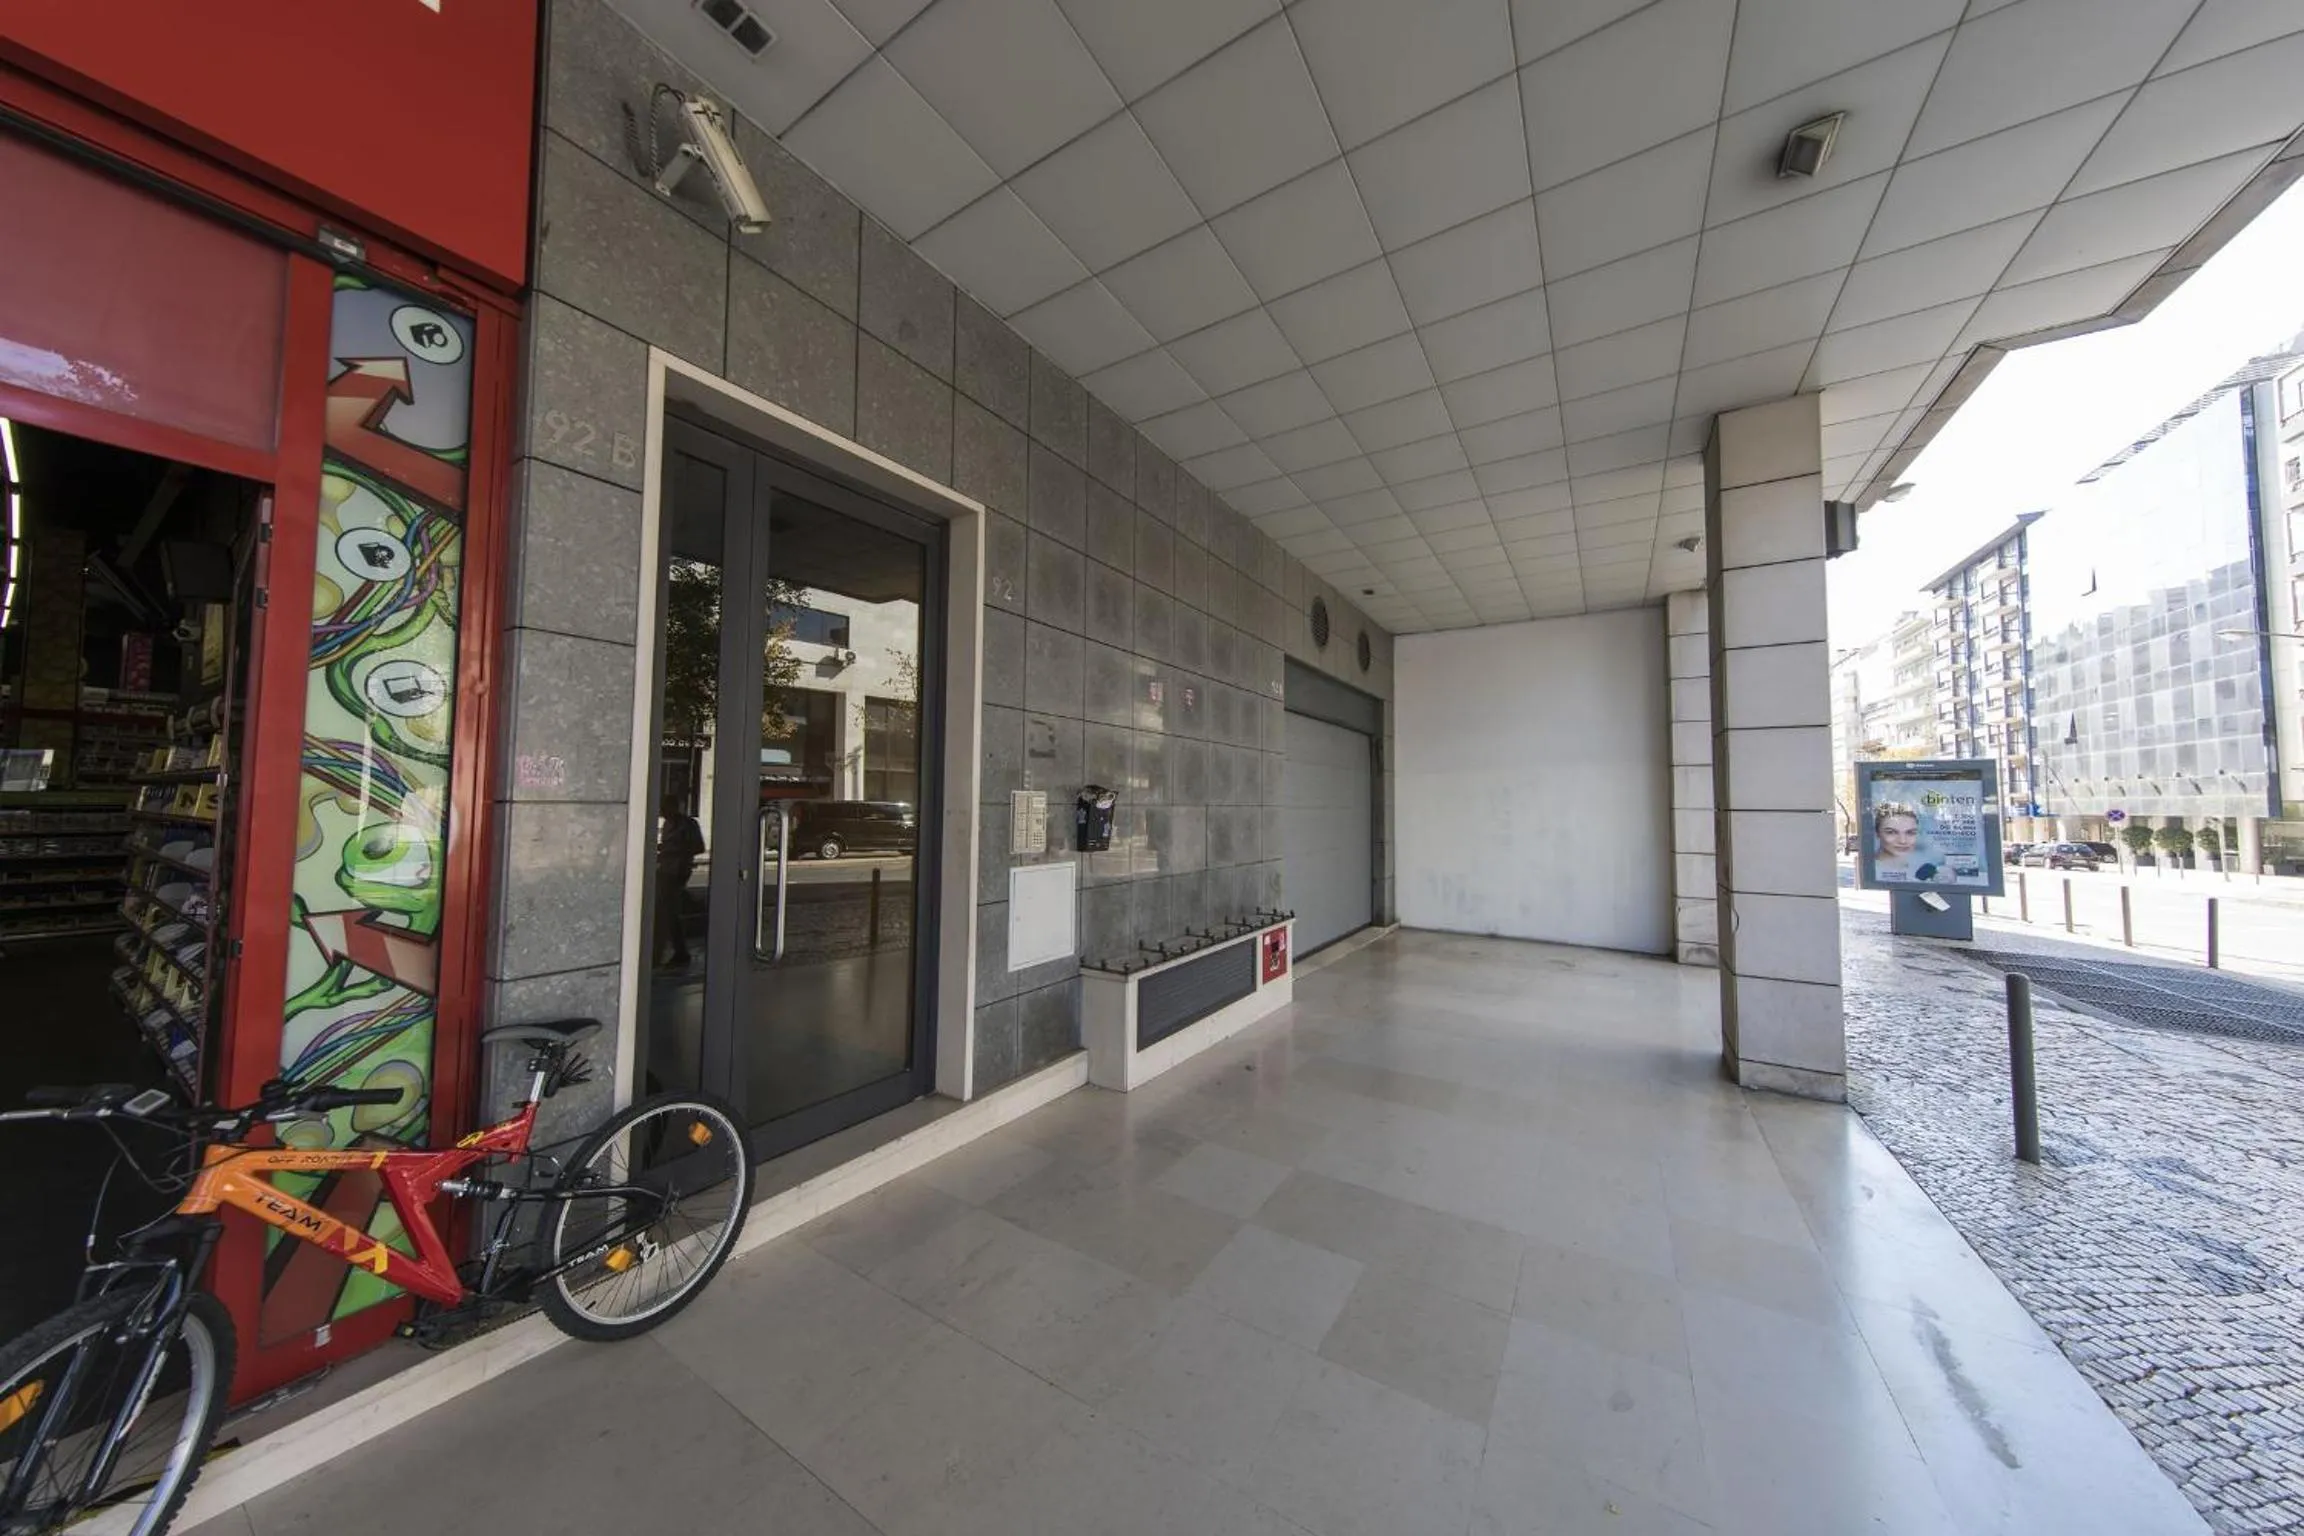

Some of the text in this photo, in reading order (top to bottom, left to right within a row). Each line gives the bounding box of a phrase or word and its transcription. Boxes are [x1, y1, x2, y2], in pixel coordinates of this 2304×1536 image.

[545, 409, 637, 468] 92 B
[992, 576, 1016, 601] 92
[255, 1191, 322, 1231] TEAM
[567, 1243, 609, 1268] TEAM
